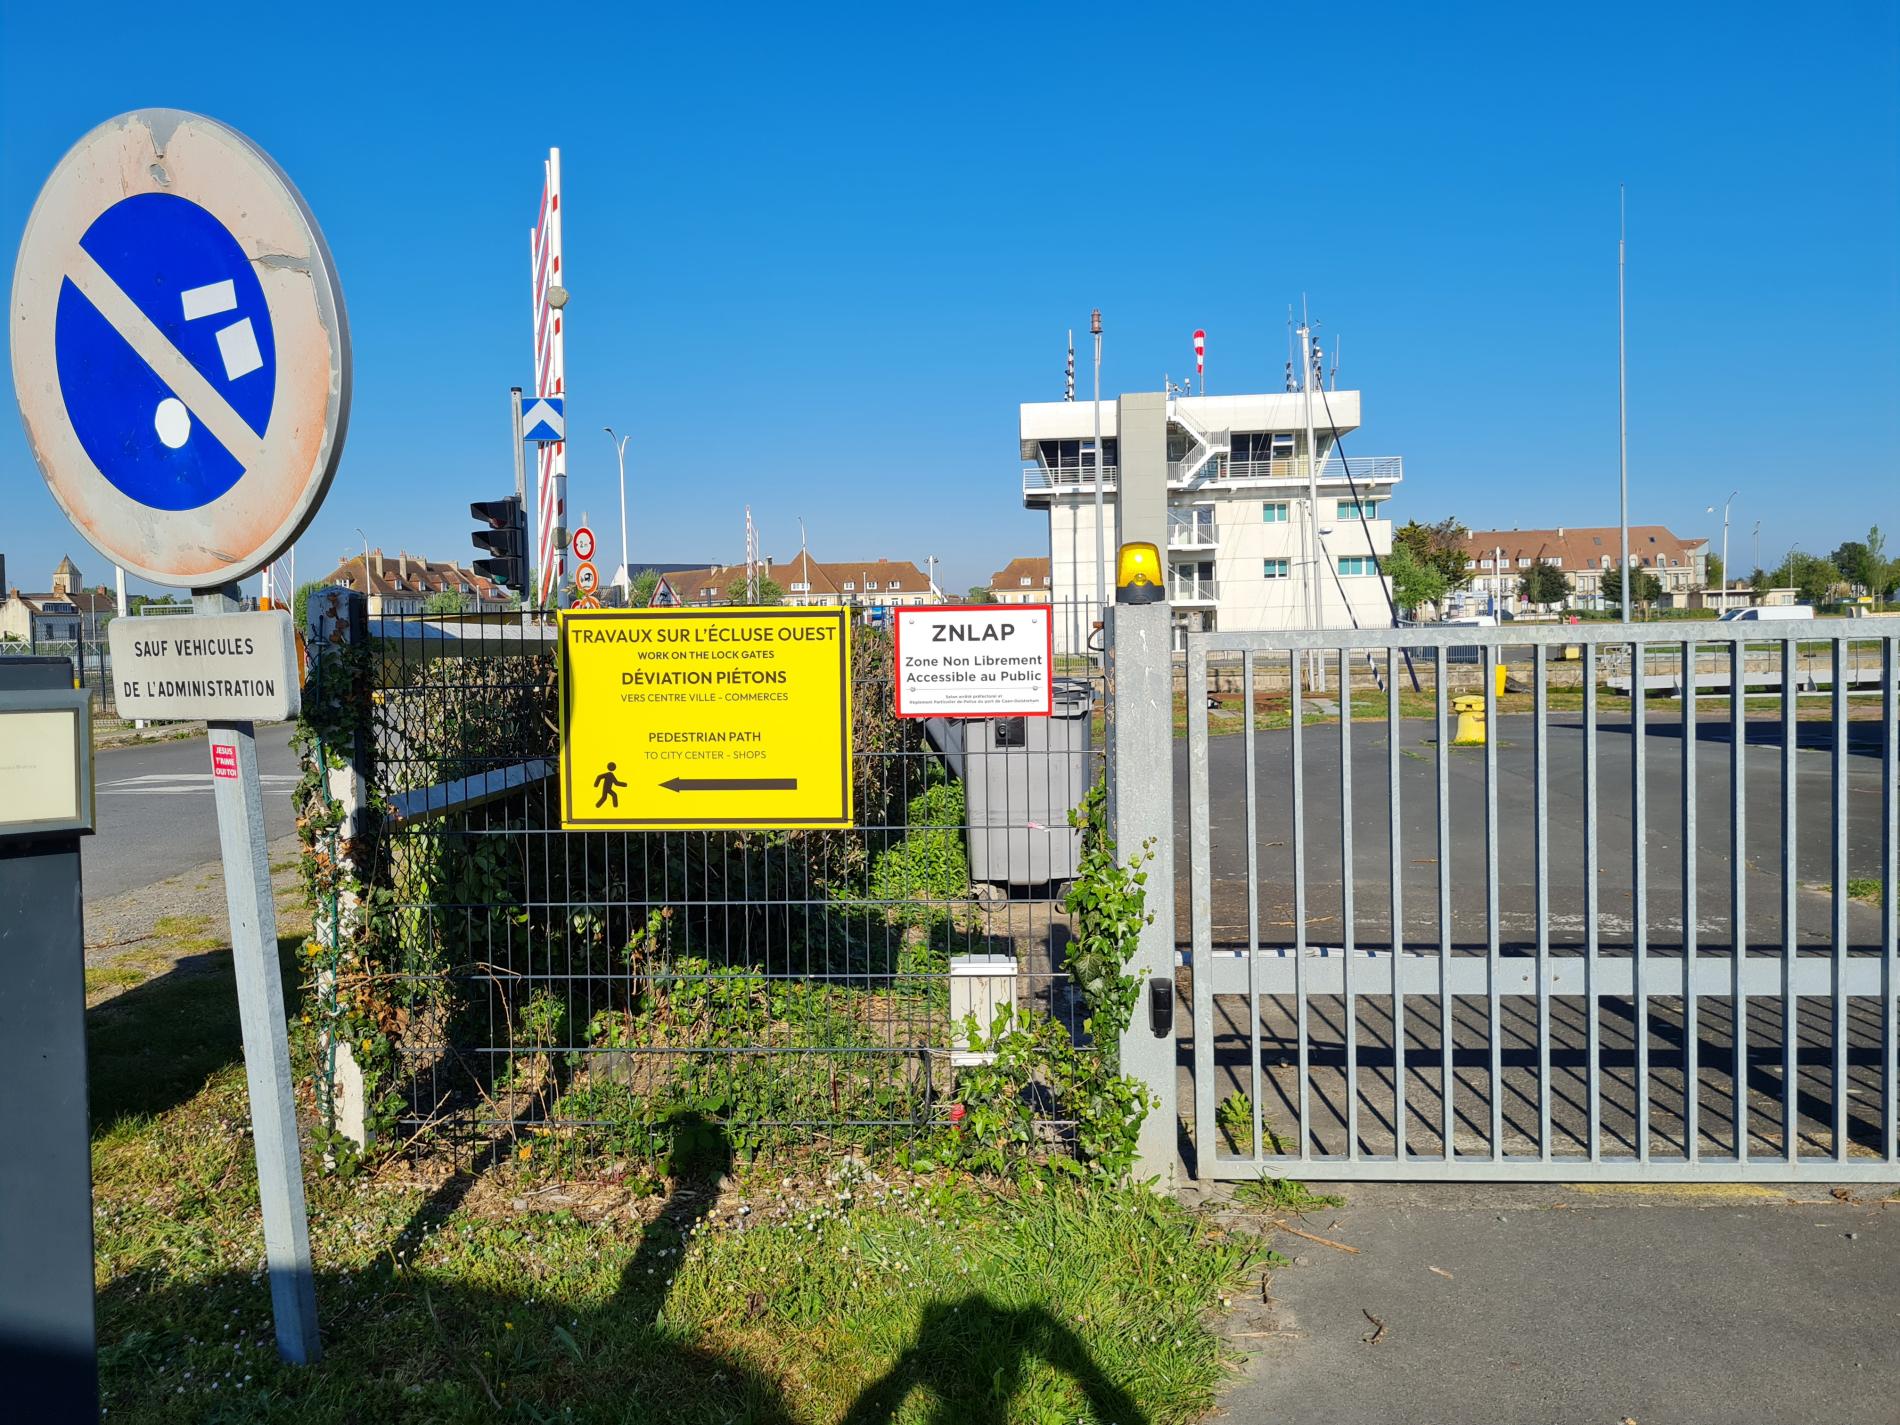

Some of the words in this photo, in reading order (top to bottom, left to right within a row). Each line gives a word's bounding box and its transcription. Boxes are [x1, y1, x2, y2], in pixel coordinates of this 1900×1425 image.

[571, 629, 652, 644] TRAVAUX
[657, 628, 690, 643] SUR
[778, 626, 836, 641] OUEST
[931, 623, 1015, 642] ZNLAP
[134, 640, 168, 657] SAUF
[174, 637, 254, 656] VEHICULES
[637, 651, 669, 660] WORK
[671, 651, 687, 660] ON
[689, 650, 709, 660] THE
[711, 650, 739, 660] LOCK
[741, 650, 775, 659] GATES
[905, 656, 939, 667] Zone
[943, 655, 970, 666] Non
[974, 655, 1043, 666] Librement
[622, 668, 712, 685] DÉVIATION
[716, 667, 787, 684] PIÉTONS
[906, 672, 976, 683] Accessible
[980, 673, 996, 682] au
[1000, 670, 1042, 681] Public
[124, 681, 141, 697] DE
[147, 679, 275, 697] L'ADMINISTRATION
[621, 694, 646, 703] VERS
[647, 693, 687, 702] CENTRE
[689, 692, 716, 702] VILLE
[724, 692, 789, 701] COMMERCES
[648, 731, 726, 743] PEDESTRIAN
[728, 731, 761, 742] PATH
[644, 751, 659, 760] TO
[660, 751, 682, 760] CITY
[684, 751, 724, 760] CENTER
[733, 750, 767, 759] SHOPS
